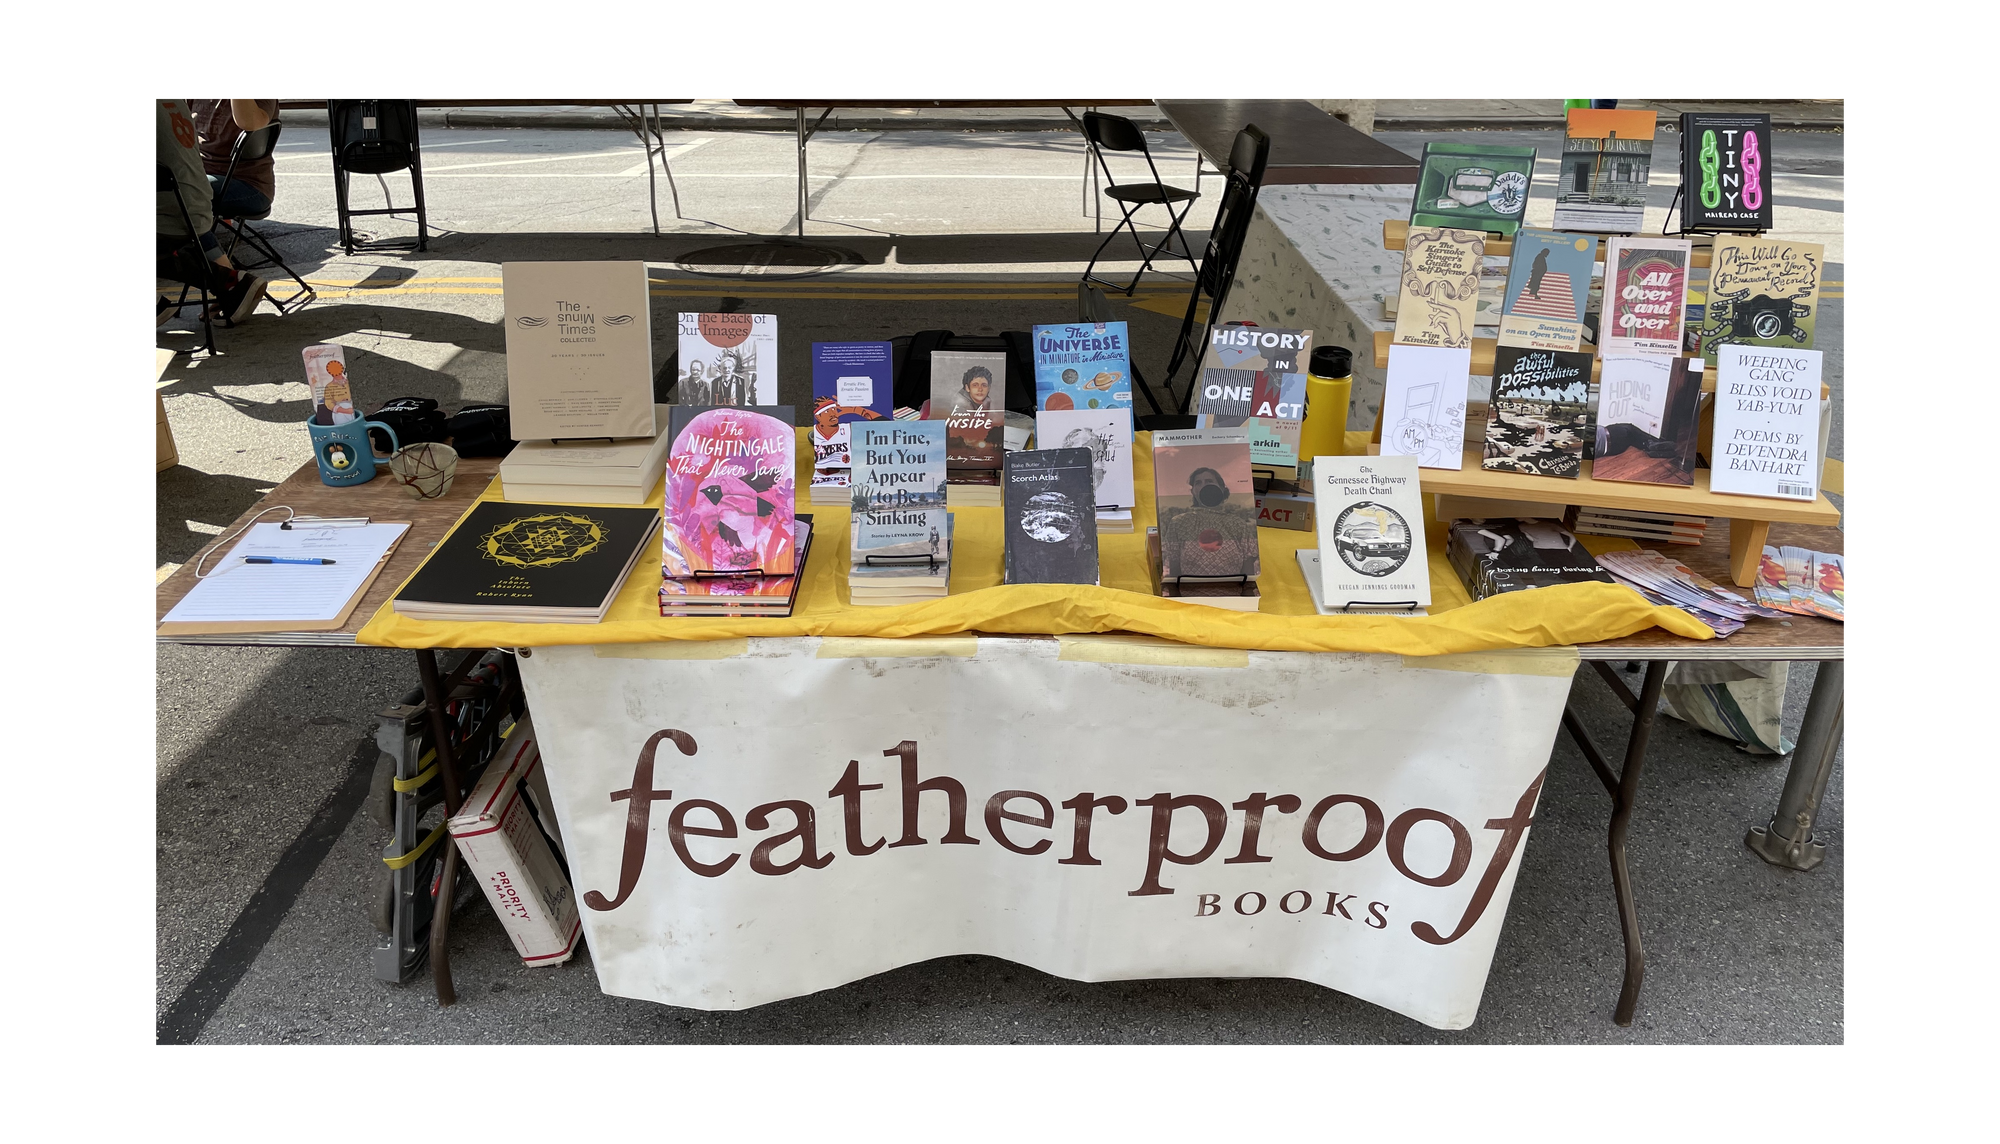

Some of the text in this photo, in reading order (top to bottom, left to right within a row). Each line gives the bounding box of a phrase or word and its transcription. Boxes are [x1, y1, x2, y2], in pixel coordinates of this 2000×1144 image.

[1570, 139, 1588, 151] SEE
[1616, 140, 1626, 151] IN
[1629, 140, 1644, 153] THE
[1722, 130, 1738, 209] TINY
[1494, 173, 1525, 188] Daddy's
[1425, 245, 1466, 256] Karaoke
[1426, 253, 1463, 262] Singer's
[1720, 246, 1797, 265] This Will Go
[1425, 260, 1452, 268] Guide
[1780, 261, 1807, 276] Your
[1639, 272, 1673, 286] All
[1719, 270, 1811, 292] Permanent Record
[1622, 285, 1672, 301] Over
[556, 300, 581, 311] The
[1634, 302, 1673, 315] and
[557, 313, 595, 324] Minus
[698, 313, 717, 323] the
[721, 312, 751, 324] Back
[754, 314, 766, 324] of
[1619, 313, 1670, 329] Over
[558, 323, 596, 335] Times
[703, 324, 749, 339] Images
[1065, 327, 1090, 339] The
[1422, 331, 1440, 339] Tim
[1530, 330, 1551, 339] Open
[1552, 333, 1576, 341] Tomb
[1538, 324, 1577, 334] Sunshine
[1040, 334, 1121, 353] UNIVERSE
[1212, 330, 1310, 350] HISTORY
[1402, 336, 1440, 345] Kinsella
[1545, 342, 1574, 350] Kinsella
[1649, 342, 1677, 350] Kinsella
[1040, 351, 1125, 365] IN MINIATURE in Miniature
[1275, 360, 1290, 369] IN
[1514, 352, 1555, 373] awful
[1739, 355, 1808, 371] WEEPING
[1496, 367, 1580, 394] possibilities
[1749, 368, 1795, 382] GANG
[1205, 385, 1252, 402] ONE
[1609, 380, 1651, 401] HIDING
[1729, 383, 1812, 400] BLISS VOID
[951, 404, 971, 417] From
[1256, 401, 1301, 418] ACT
[1608, 398, 1631, 418] OUT
[1736, 399, 1803, 415] YAB-YUM
[720, 421, 743, 436] The
[945, 418, 992, 430] INSIDE
[865, 429, 931, 447] I'm Fine,
[1159, 434, 1203, 442] MAMMOTHER
[1253, 440, 1280, 448] arkin
[1733, 429, 1804, 445] POEMS BY
[685, 433, 785, 457] NIGHTINGALE
[1725, 443, 1808, 461] DEVENDRA
[866, 449, 927, 465] But You
[1539, 455, 1569, 469] Christian
[672, 455, 791, 482] That Never Sang
[1729, 458, 1805, 476] BANHART
[866, 468, 926, 486] Appear
[1011, 474, 1038, 483] Scorch
[1328, 474, 1407, 486] Tennessee Highway
[877, 489, 917, 504] to Be
[1344, 487, 1367, 496] Death
[866, 510, 927, 527] Sinking
[1258, 508, 1293, 522] ACT
[584, 727, 1547, 945] featherproof
[493, 884, 510, 910] MAIL
[1194, 890, 1390, 929] BOOKS
